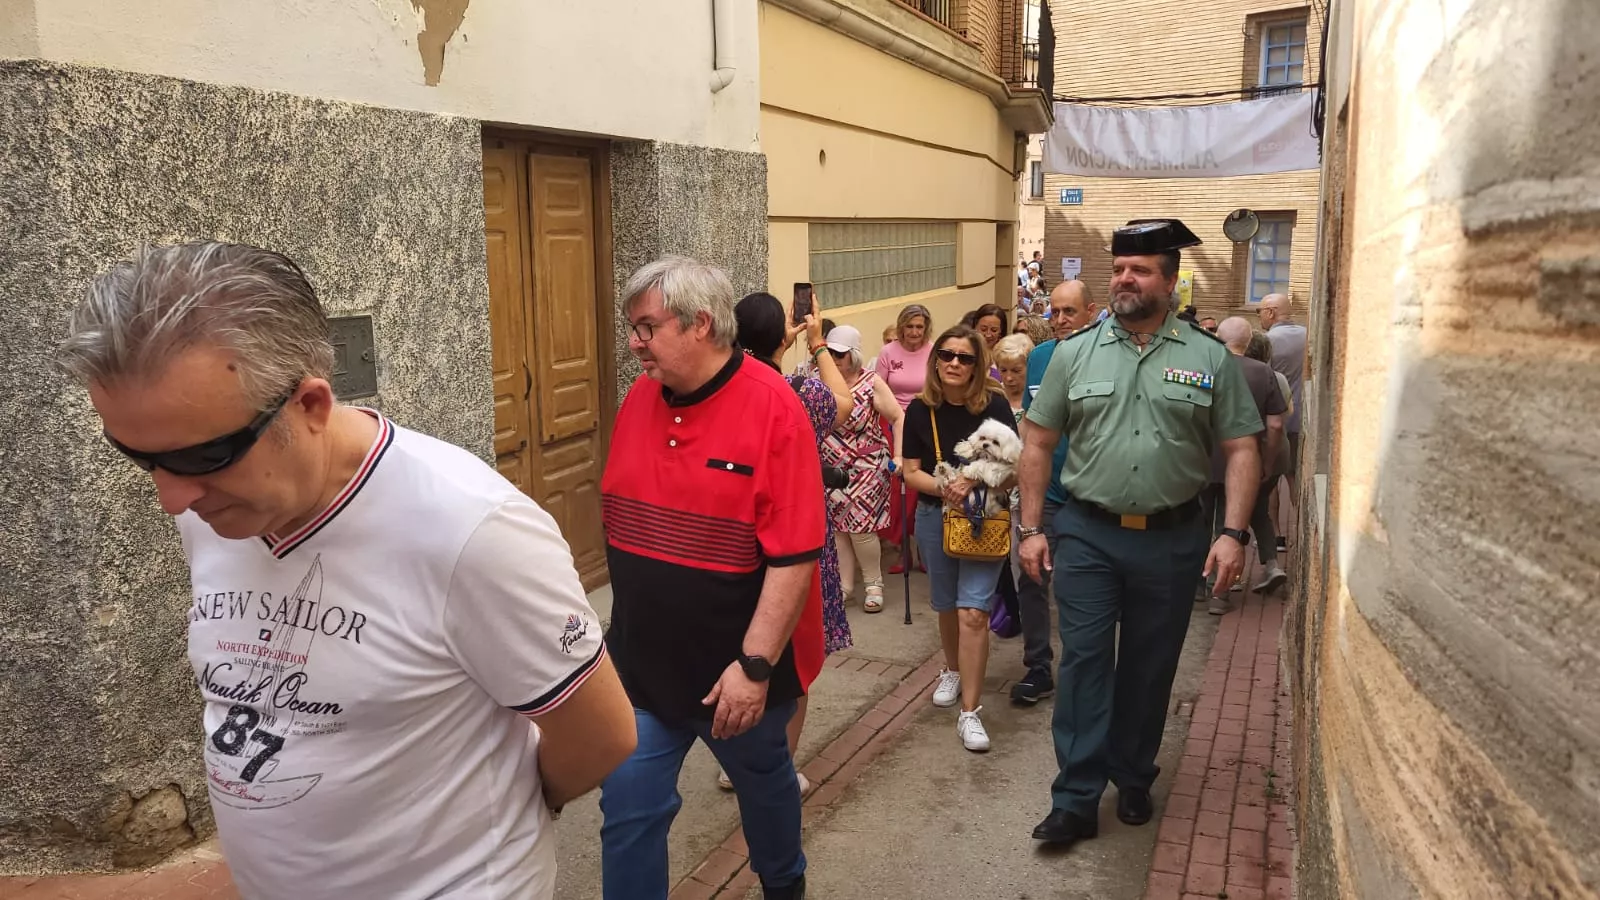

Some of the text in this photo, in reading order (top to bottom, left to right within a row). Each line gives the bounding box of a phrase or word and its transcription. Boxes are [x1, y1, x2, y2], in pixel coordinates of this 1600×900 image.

[194, 590, 367, 644] NEW SAILOR
[216, 640, 308, 664] NORTH EXPEDITION
[234, 657, 261, 668] SAILING
[199, 662, 343, 715] Nautik Ocean
[212, 704, 286, 783] 87
